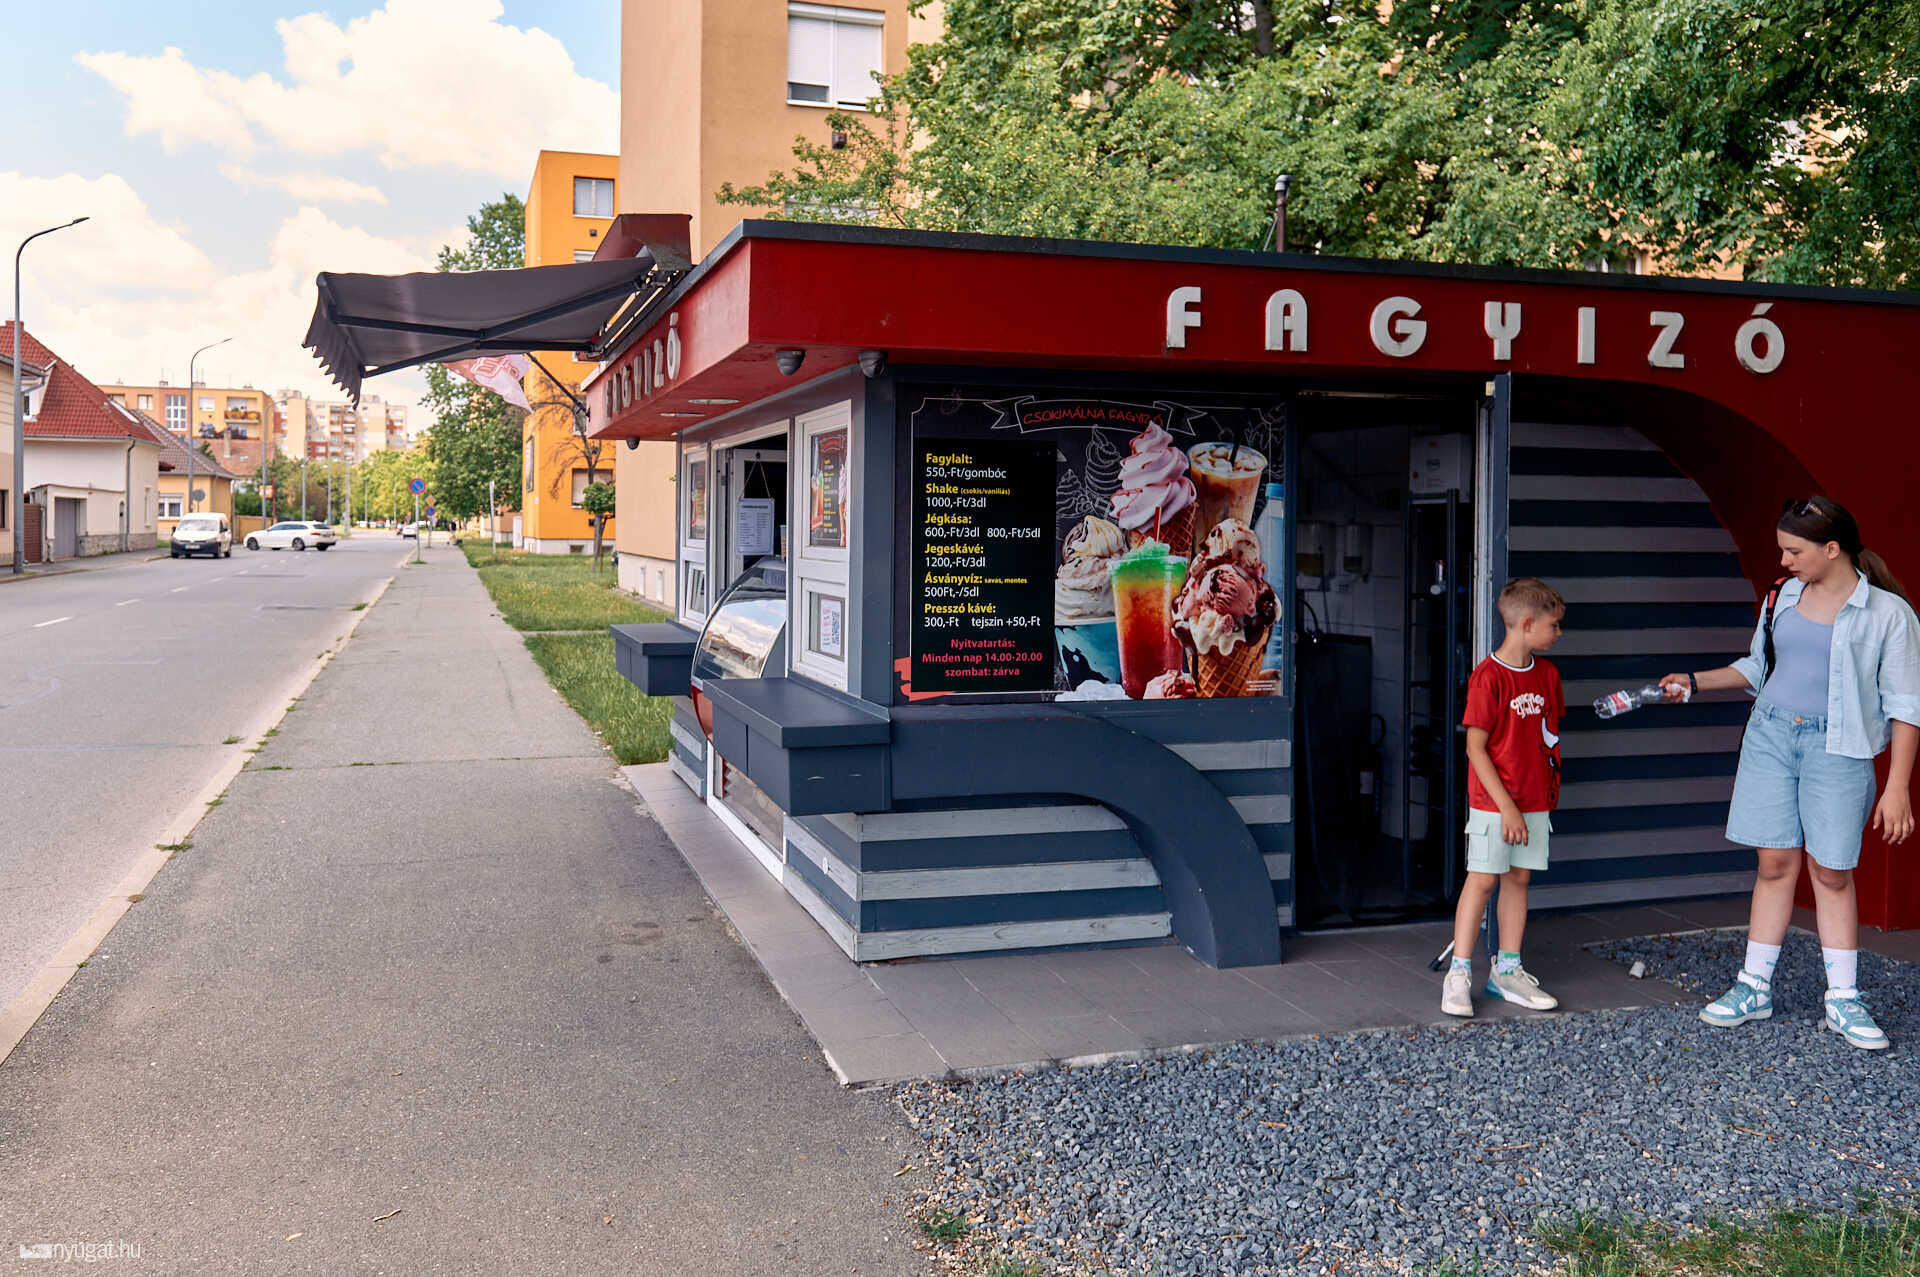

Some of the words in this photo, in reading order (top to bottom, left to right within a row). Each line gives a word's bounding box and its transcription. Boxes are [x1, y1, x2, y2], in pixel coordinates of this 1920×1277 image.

[1165, 285, 1786, 374] FAGYIZÓ
[926, 453, 973, 466] Fagylalt:
[925, 466, 1007, 480] 550,-Ft/gombóc
[925, 482, 959, 494] Shake
[925, 497, 987, 509] 1000,-Ft/3dl
[924, 513, 972, 526] Jégkása:
[924, 526, 980, 538] 600,-Ft/3dl
[987, 527, 1041, 539] 800,-Ft/5dl
[924, 543, 984, 556] Jegeskávé:
[925, 556, 986, 568] 1200,-Ft/3dl
[924, 571, 983, 586] Ásványvíz:
[924, 586, 980, 598] 500Ft,-/5dl
[924, 603, 966, 614] Presszó
[967, 602, 997, 614] kávé:
[924, 616, 960, 628] 300,-Ft
[1005, 615, 1041, 628] +50,-Ft
[950, 638, 1016, 650] Nyitvatartás:
[922, 652, 961, 663] Minden
[962, 655, 983, 665] nap
[984, 651, 1043, 663] 14.00-20.00
[945, 667, 991, 677] szombat:
[992, 666, 1020, 676] zárva
